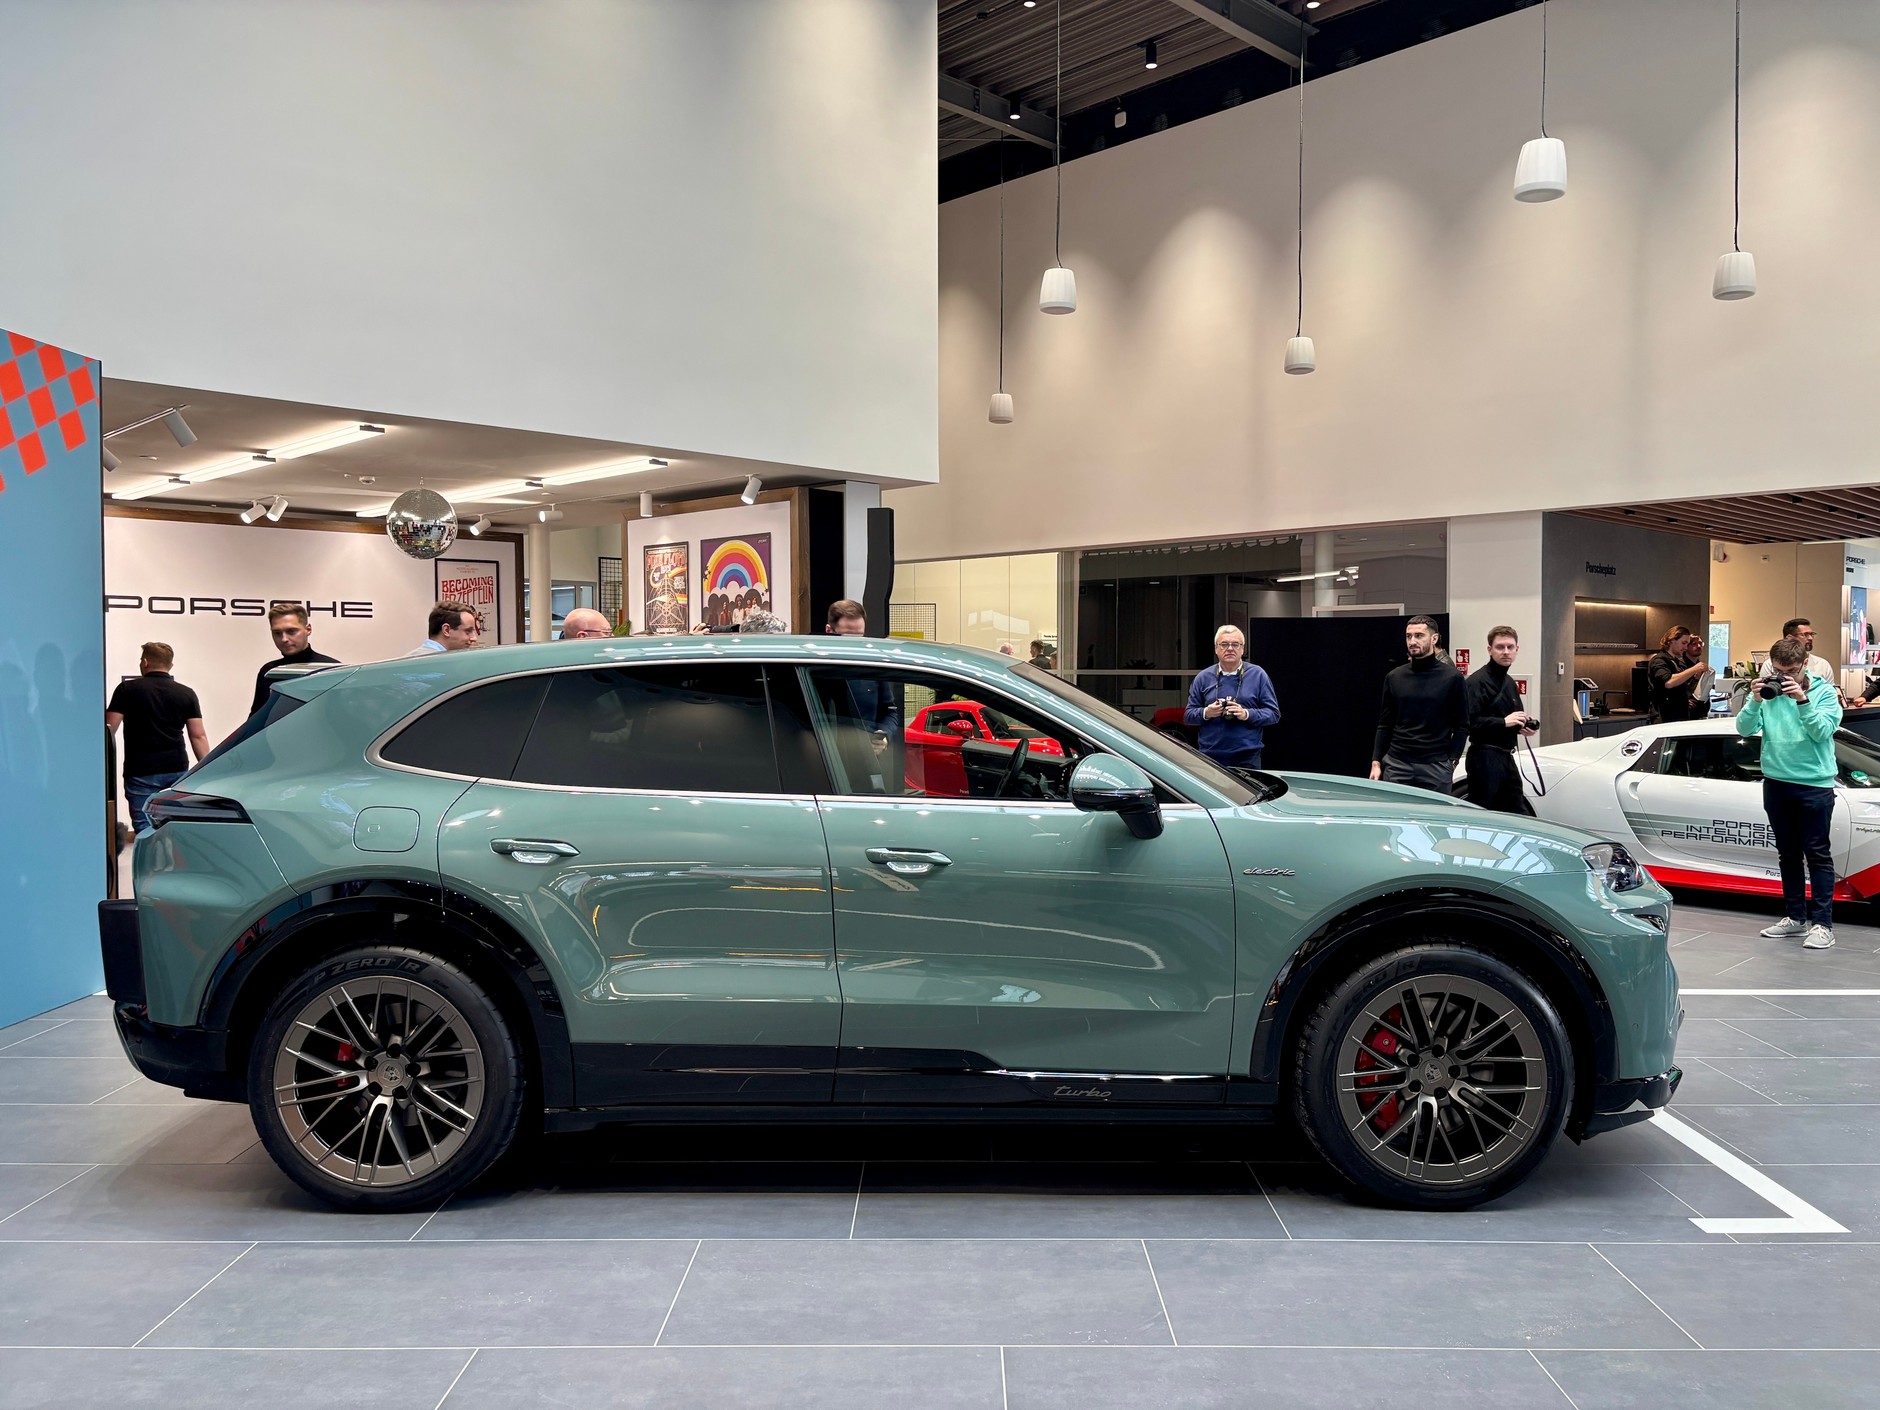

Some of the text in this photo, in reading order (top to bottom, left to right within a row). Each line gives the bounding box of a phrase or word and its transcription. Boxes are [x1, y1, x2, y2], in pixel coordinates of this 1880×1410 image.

[1585, 561, 1617, 578] Porscheplatz
[441, 575, 494, 593] BECOMING
[457, 585, 494, 605] ZEPPELIN
[1243, 866, 1296, 876] electric
[404, 961, 421, 972] R
[1053, 1085, 1112, 1098] turbo
